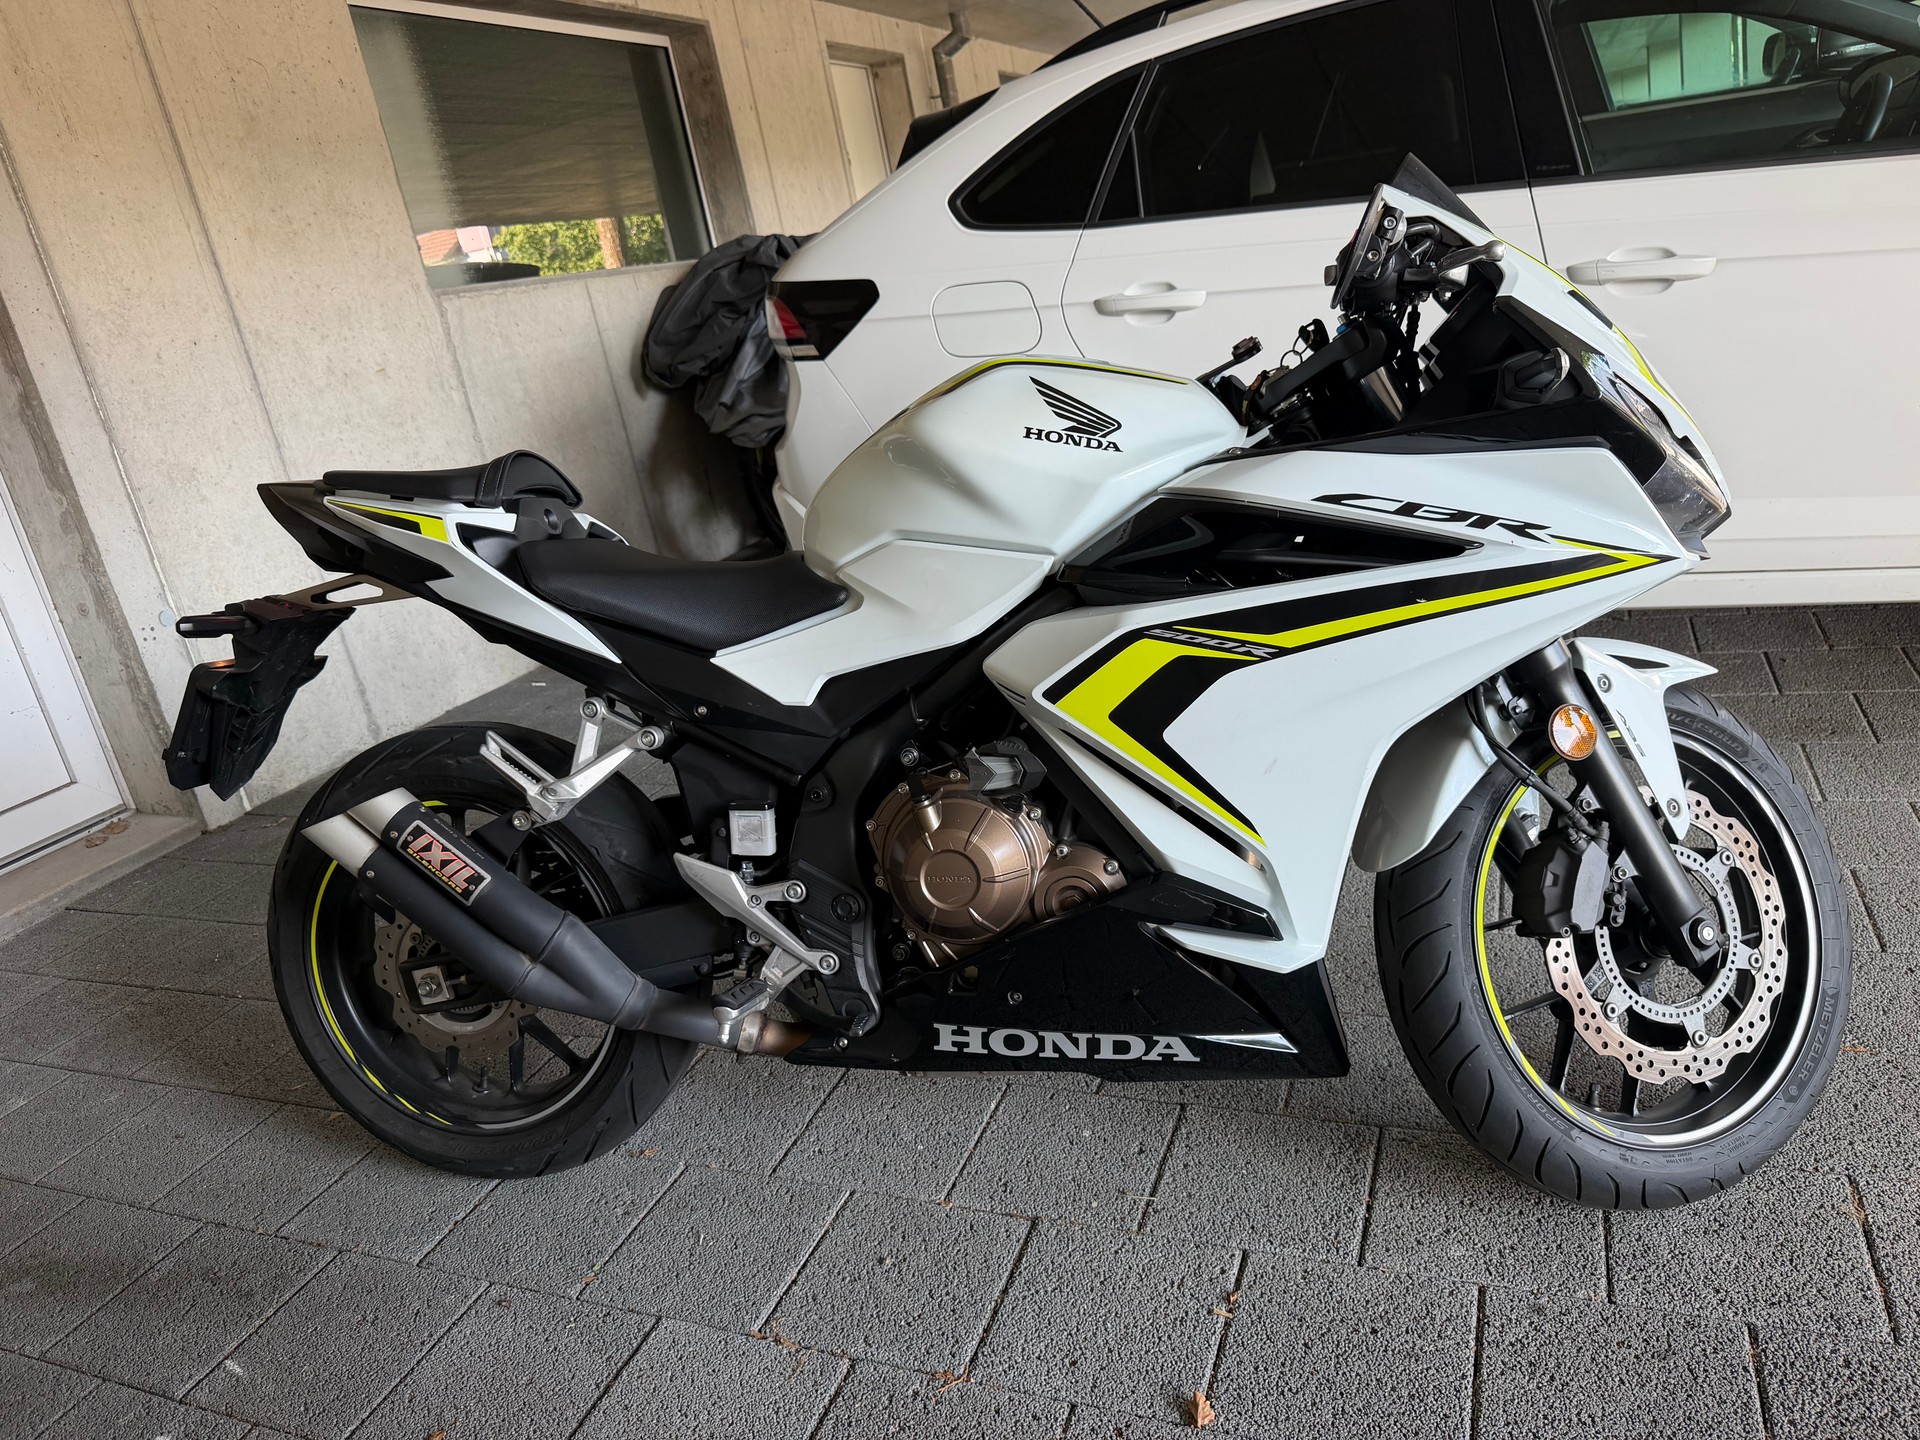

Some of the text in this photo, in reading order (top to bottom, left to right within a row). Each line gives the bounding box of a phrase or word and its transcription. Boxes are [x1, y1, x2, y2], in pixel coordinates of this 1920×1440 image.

[1023, 426, 1124, 453] HONDA
[1310, 493, 1552, 545] CBR
[1143, 628, 1280, 659] 500R
[406, 848, 463, 894] SILENCERS
[408, 833, 477, 890] IXIL
[932, 1023, 1201, 1062] HONDA
[1799, 995, 1836, 1086] METZELER
[1501, 1060, 1569, 1130] SPORTEC
